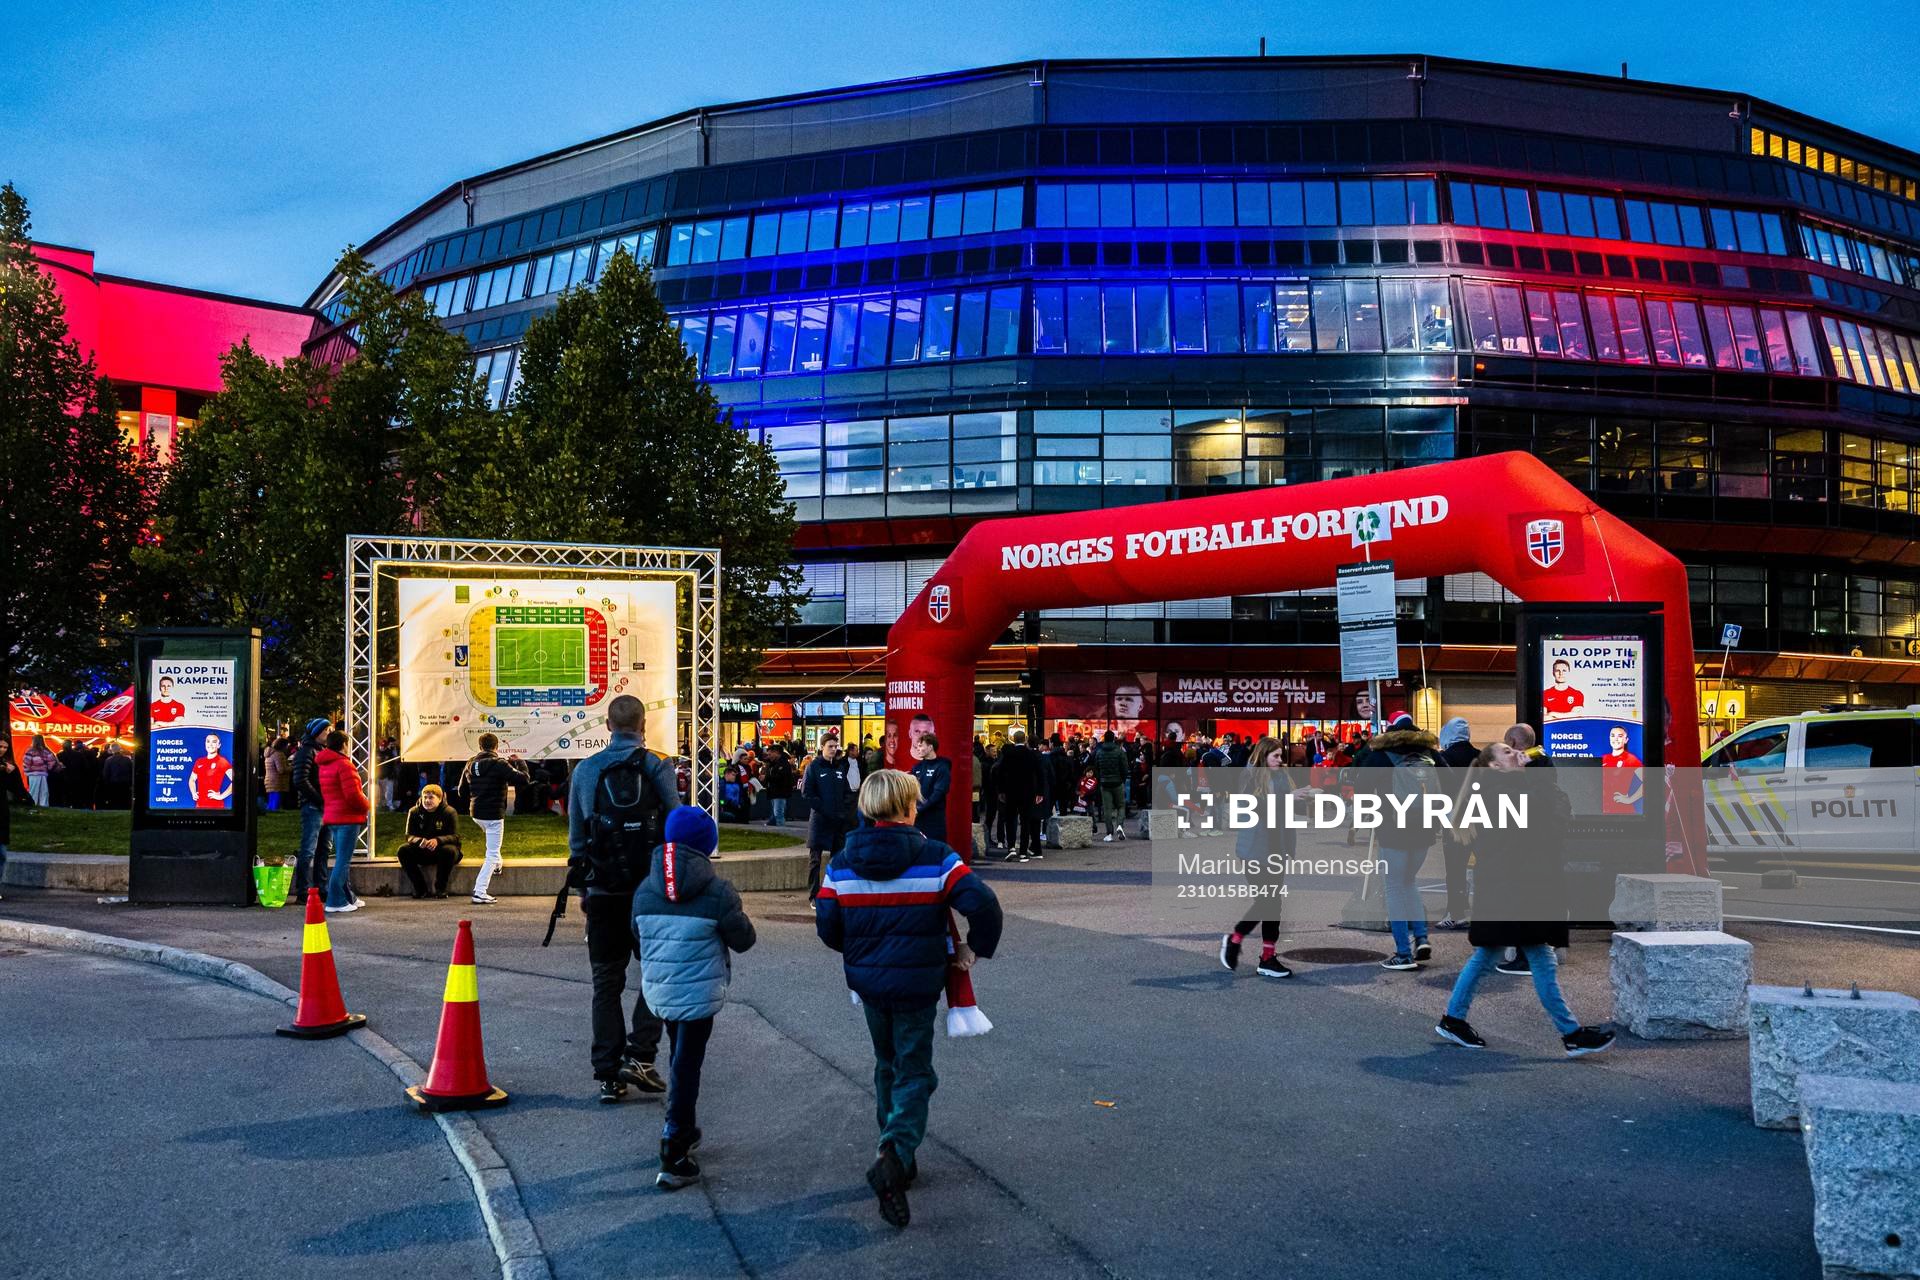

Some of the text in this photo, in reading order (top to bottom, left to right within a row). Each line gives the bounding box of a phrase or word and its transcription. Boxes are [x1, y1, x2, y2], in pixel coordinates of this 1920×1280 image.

[1002, 537, 1113, 570] NORGES
[611, 639, 619, 671] VG
[1552, 648, 1635, 657] LAD OPP TIL
[159, 666, 228, 674] LAD OPP TIL
[1574, 660, 1636, 669] KAMPEN!
[177, 677, 228, 685] KAMPEN!
[1179, 679, 1309, 690] MAKE FOOTBALL
[888, 681, 926, 694] STERKERE
[889, 697, 923, 710] SAMMEN
[1162, 692, 1326, 704] DREAMS COME TRUE
[46, 723, 72, 733] FAN
[75, 724, 111, 735] SHOP
[576, 739, 611, 749] T-BAN
[156, 754, 178, 762] ÅPENT
[1811, 799, 1898, 818] POLITI
